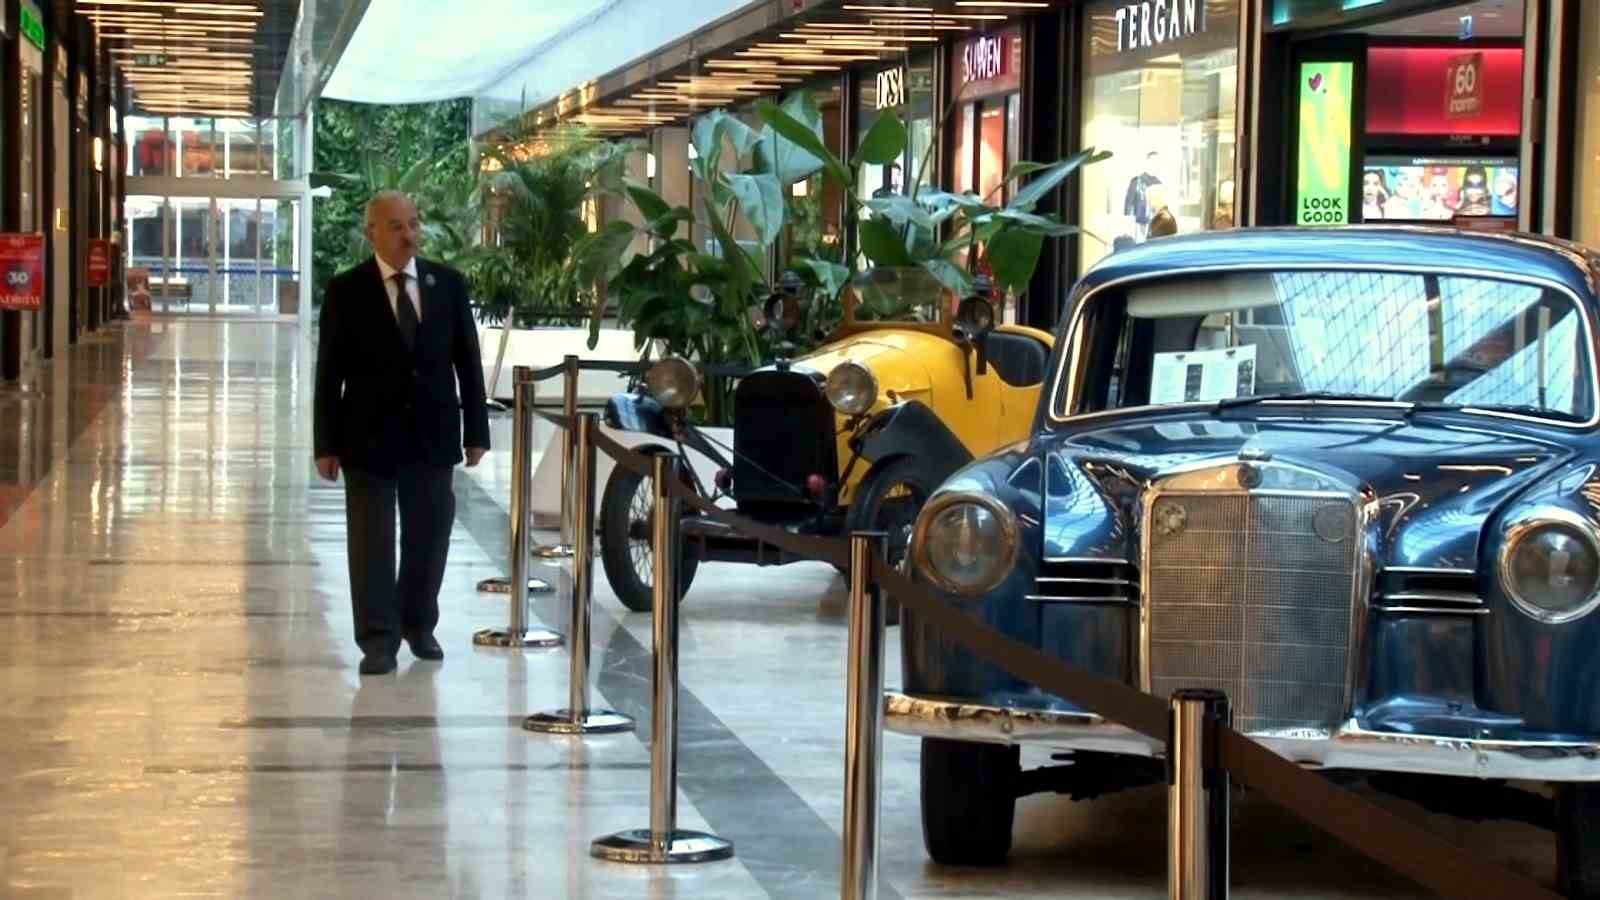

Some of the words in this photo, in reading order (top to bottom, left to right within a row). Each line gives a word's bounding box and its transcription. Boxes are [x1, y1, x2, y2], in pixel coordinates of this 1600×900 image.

[1115, 0, 1195, 52] TERGAN
[963, 37, 1001, 82] SUWEN
[876, 66, 904, 110] DESA
[1303, 197, 1342, 209] LOOK
[1303, 211, 1343, 222] GOOD
